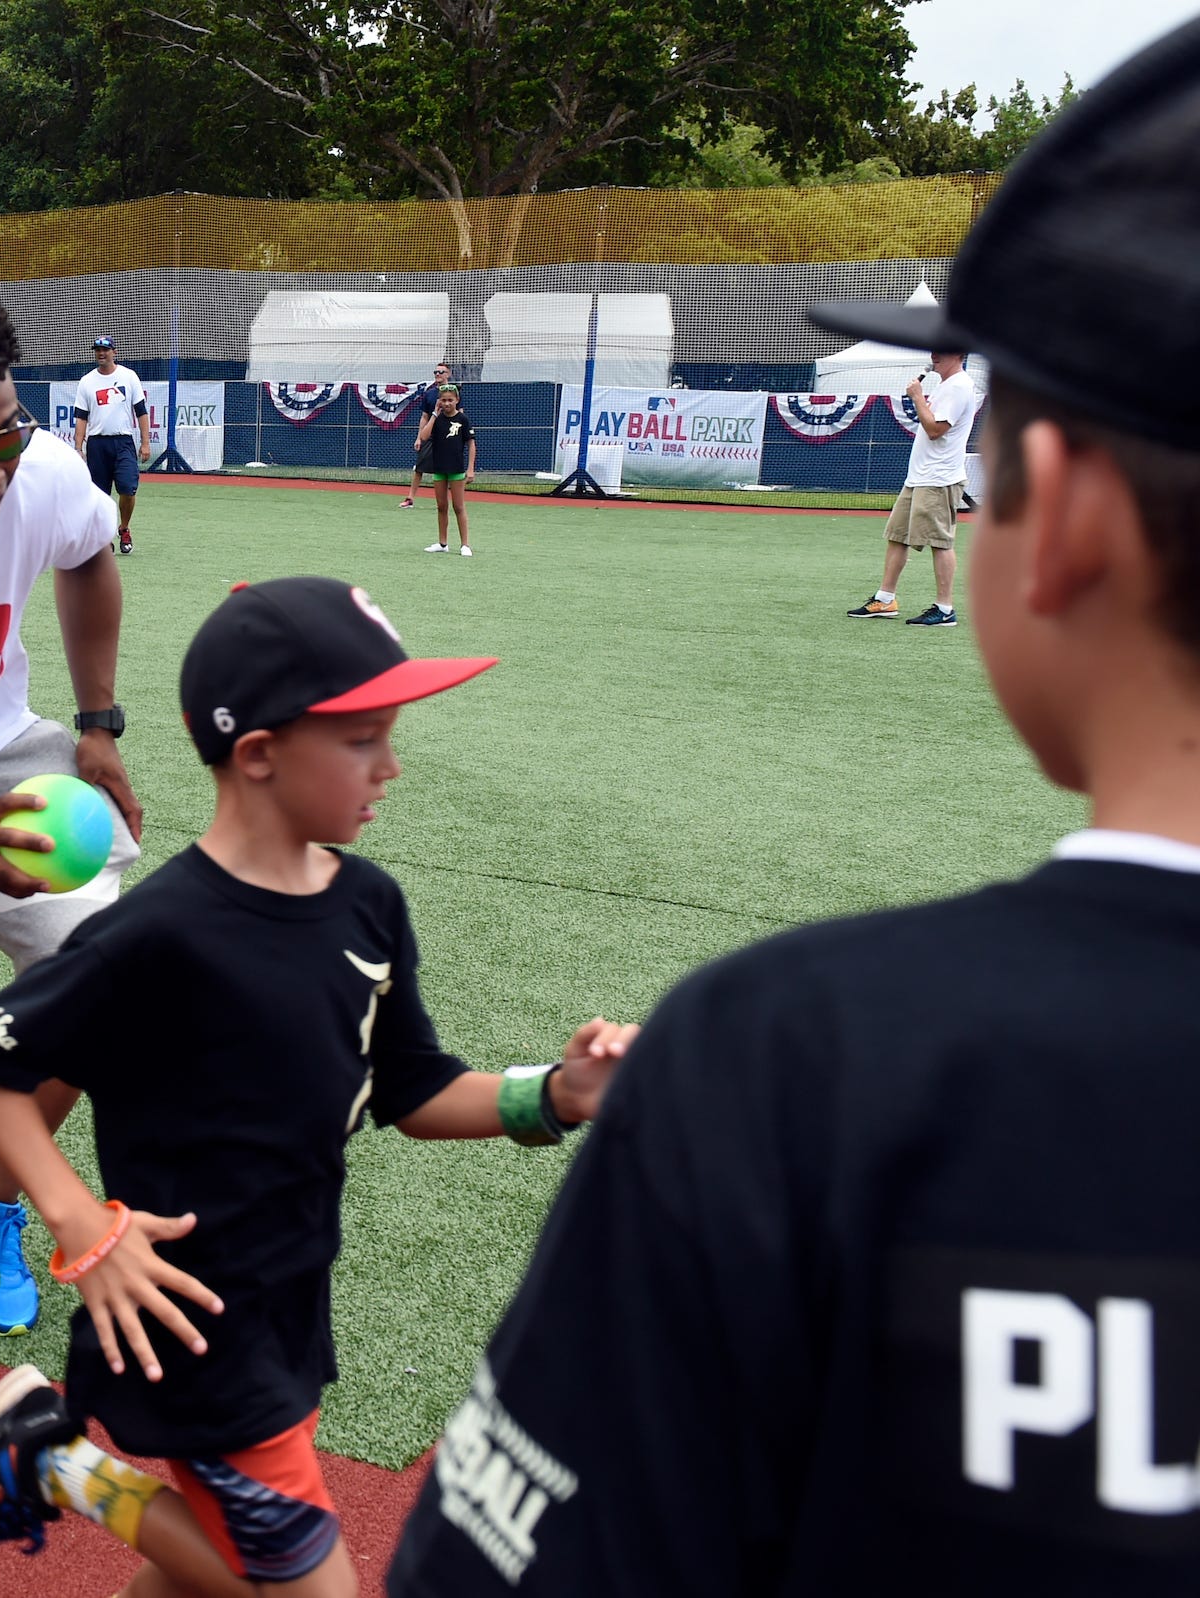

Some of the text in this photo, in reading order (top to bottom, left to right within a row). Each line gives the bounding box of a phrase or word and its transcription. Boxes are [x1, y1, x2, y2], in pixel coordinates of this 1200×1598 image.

[565, 409, 755, 443] PAY BALL PARK
[662, 443, 685, 452] USA
[213, 707, 236, 733] 6
[960, 1285, 1200, 1517] PL
